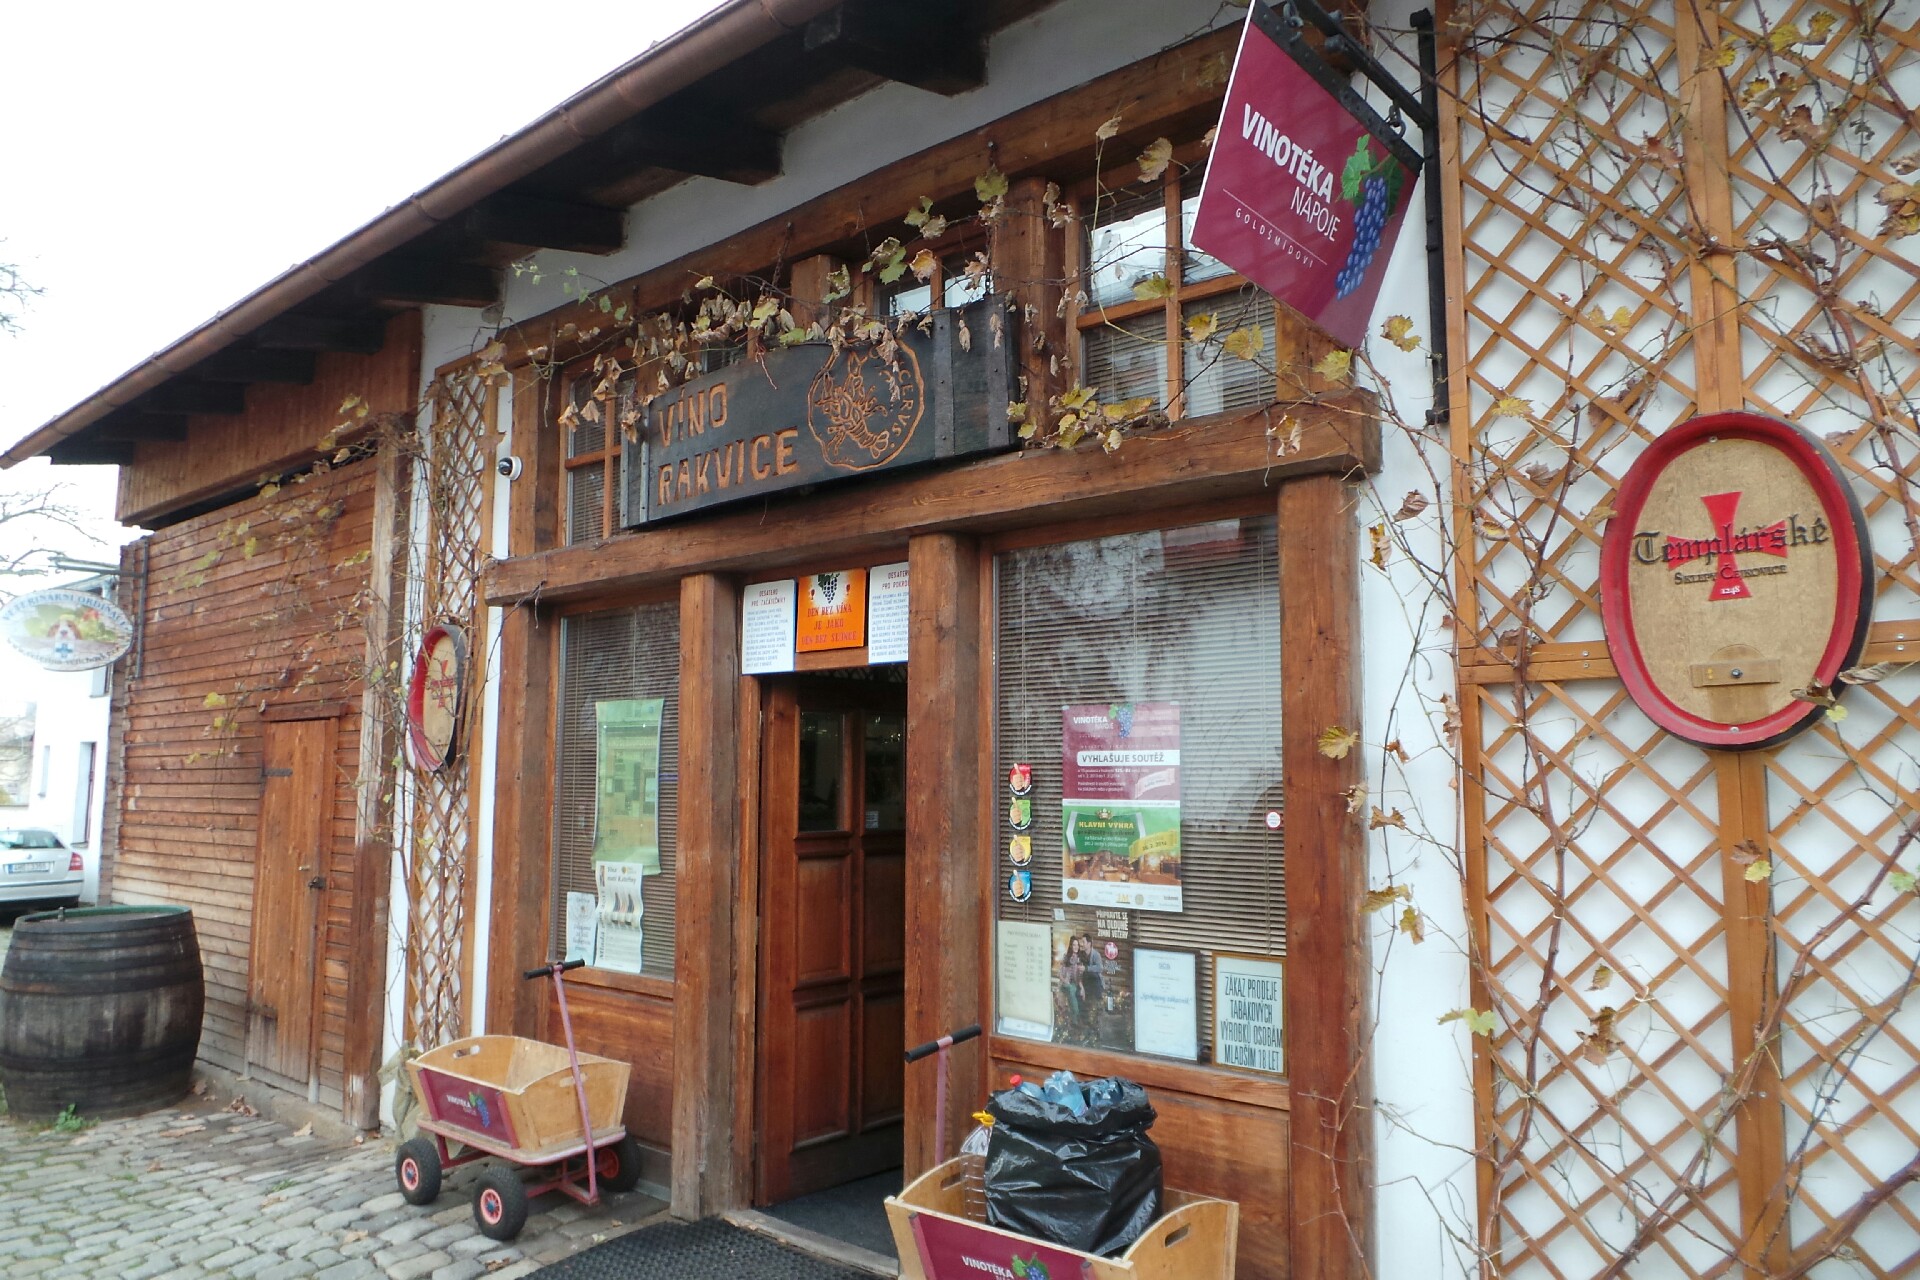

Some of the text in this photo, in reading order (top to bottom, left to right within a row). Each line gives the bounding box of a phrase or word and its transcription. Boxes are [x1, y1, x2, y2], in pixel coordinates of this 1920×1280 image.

[1242, 103, 1334, 204] VINOTÉKA
[1291, 186, 1341, 242] NÁPOJE
[658, 383, 729, 448] VÍNO
[657, 426, 800, 506] RAKVICE
[1633, 513, 1830, 566] Templářské
[888, 570, 909, 579] DESATER
[822, 605, 834, 616] BEZ
[836, 602, 853, 614] VÍNA
[1073, 715, 1108, 724] VINOTÉKA
[1082, 752, 1165, 763] VYHLAŠUJE SOUTĚŽ
[1097, 919, 1106, 928] NA
[1225, 975, 1278, 1002] ZÁKAZ PRODEJE
[1230, 998, 1273, 1024] TABÁKOVÝCH
[1221, 1019, 1283, 1048] VÝROBKŮ OSOBÁM
[1224, 1043, 1280, 1071] MLADŠÍM 18 LET
[961, 1255, 1014, 1279] VINOTÉKA
